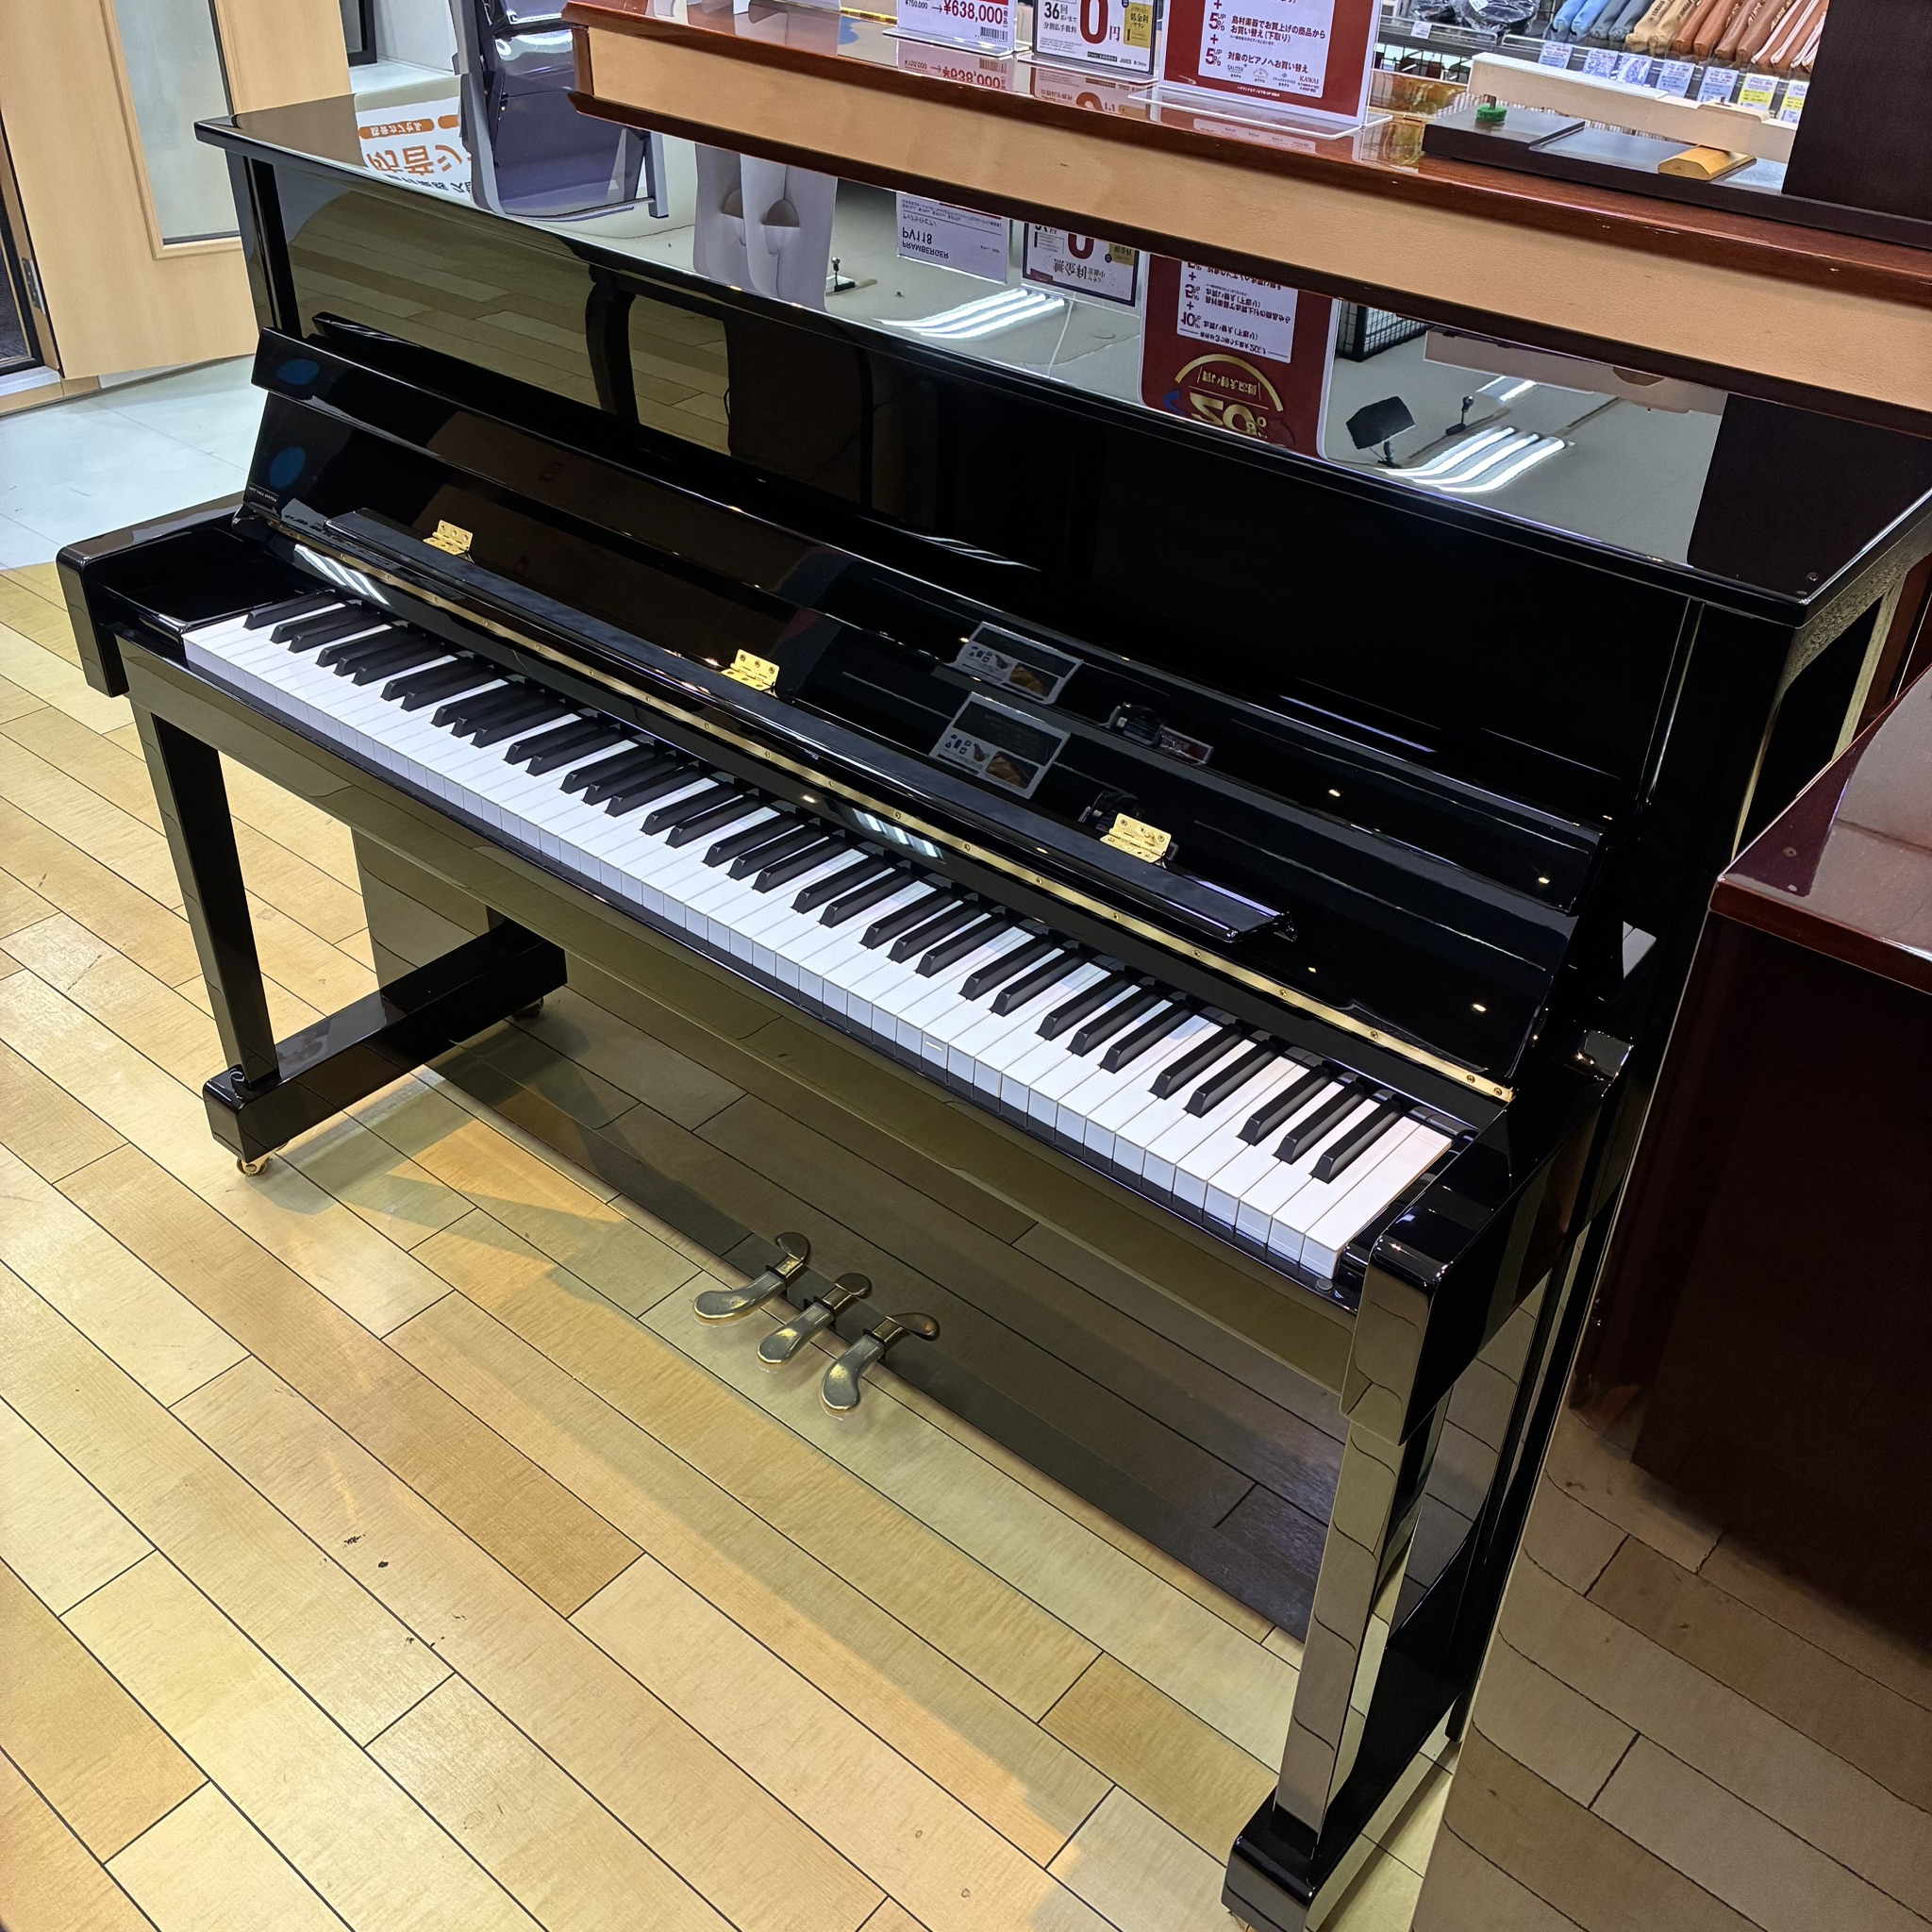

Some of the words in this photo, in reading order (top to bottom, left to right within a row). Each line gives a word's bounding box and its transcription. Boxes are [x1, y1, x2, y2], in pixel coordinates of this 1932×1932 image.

[943, 0, 1004, 25] ¥638,000
[1231, 15, 1326, 39] 島村楽器でお買上げの商品から
[1227, 51, 1308, 74] 対象のピアノへお買い替え
[1299, 75, 1319, 85] KAWAI
